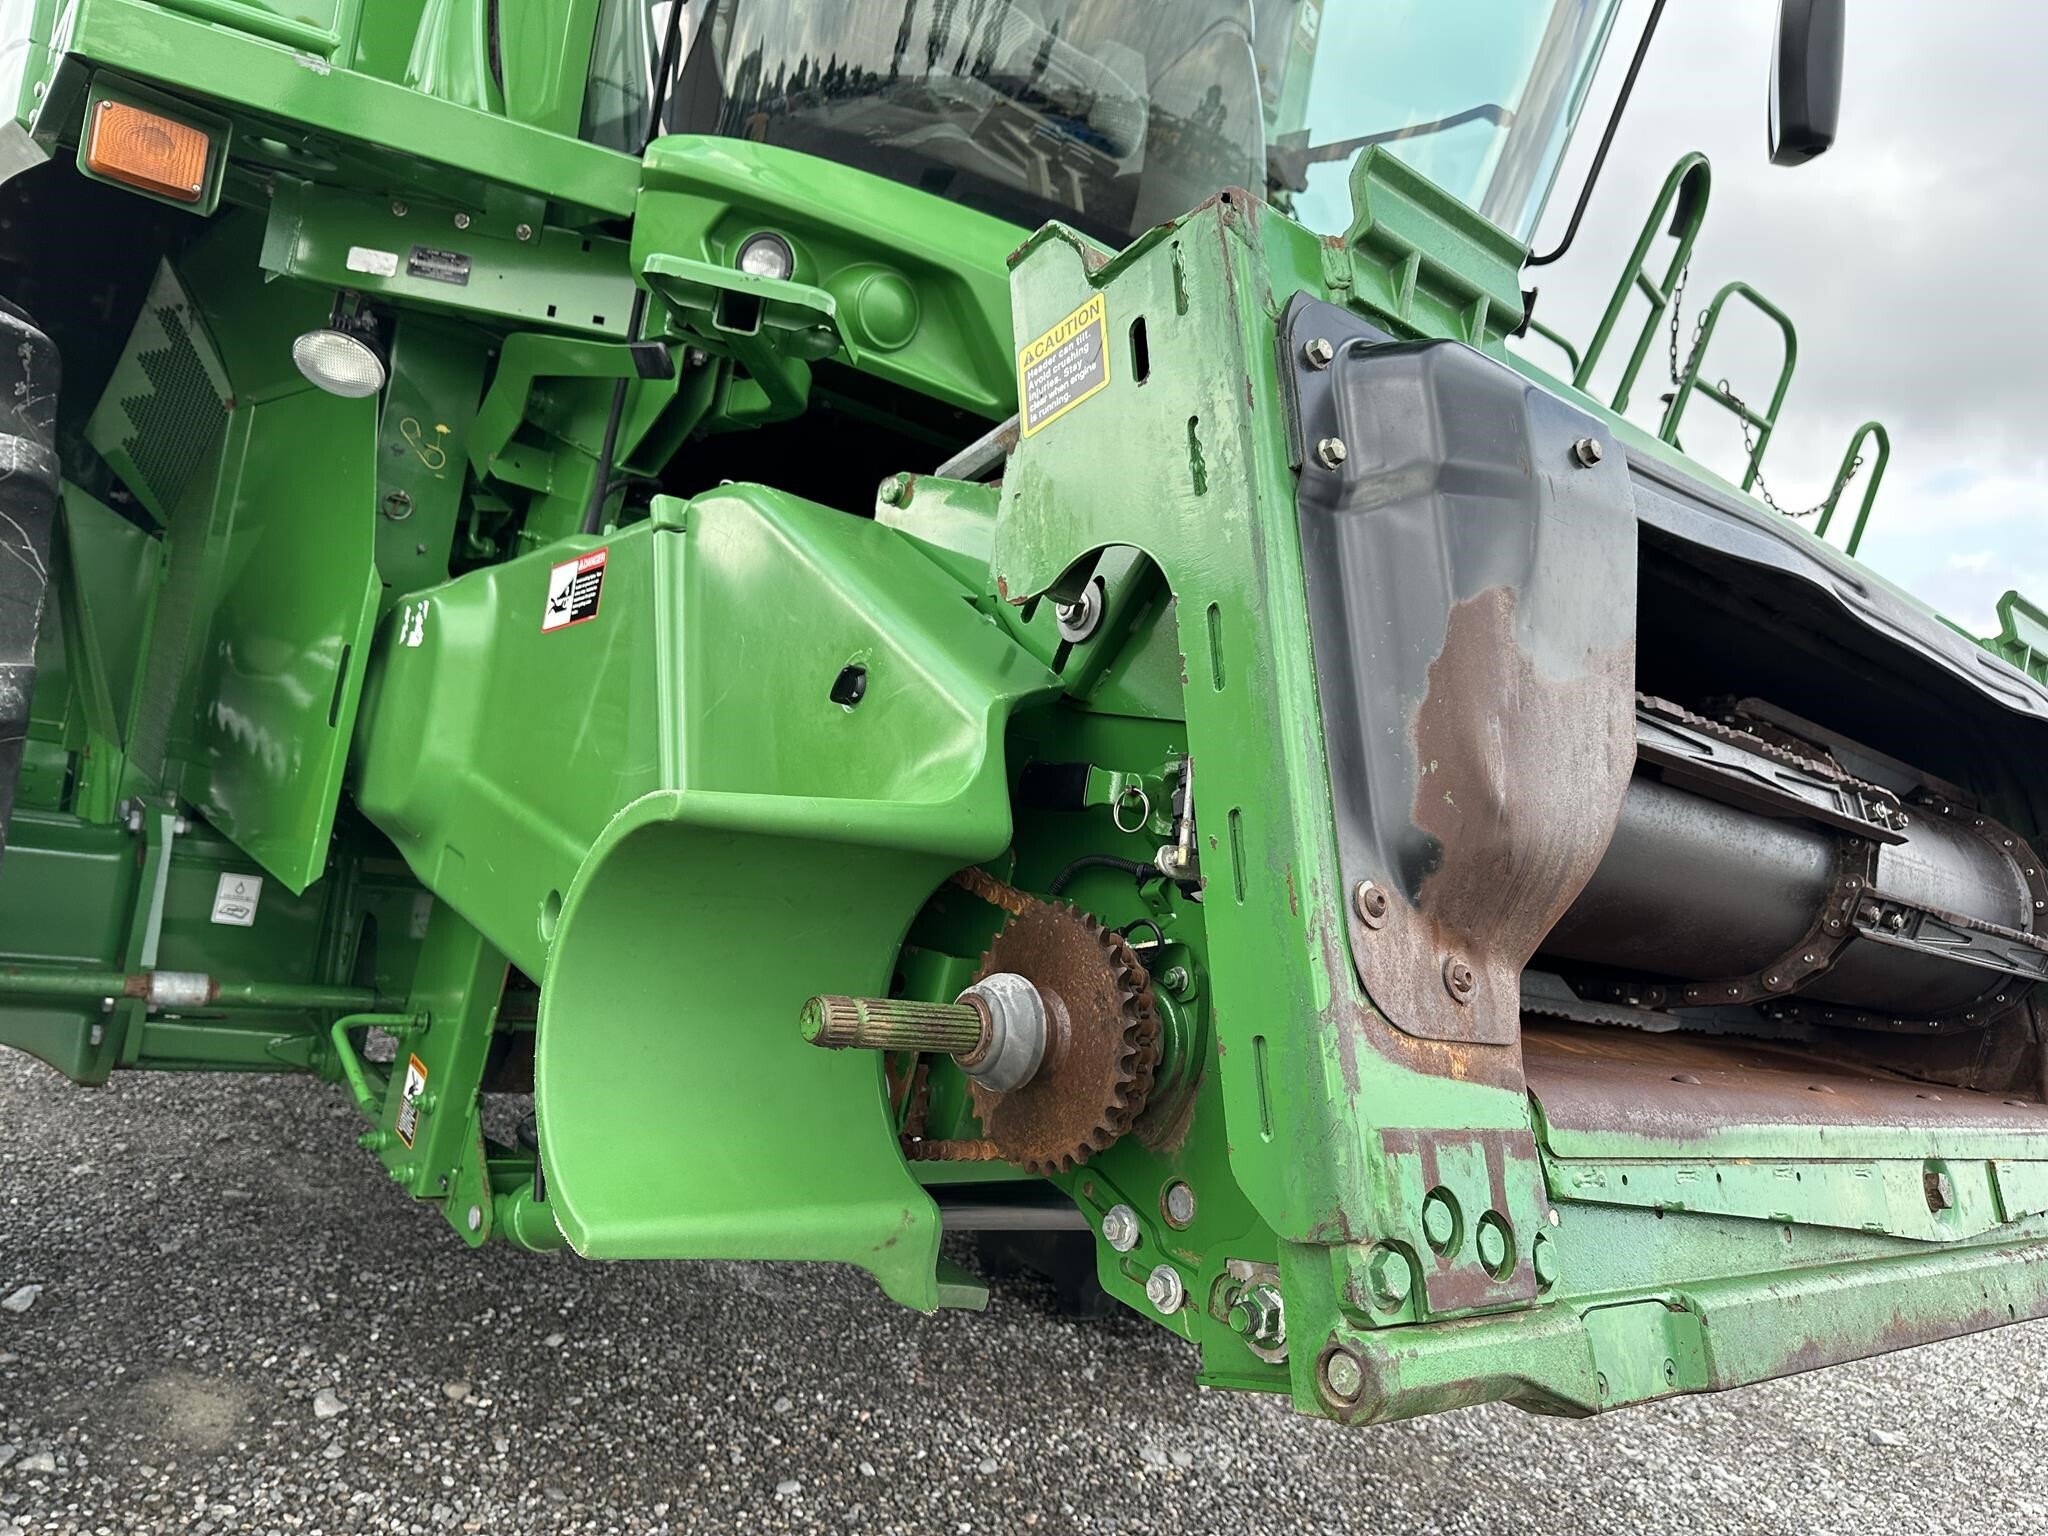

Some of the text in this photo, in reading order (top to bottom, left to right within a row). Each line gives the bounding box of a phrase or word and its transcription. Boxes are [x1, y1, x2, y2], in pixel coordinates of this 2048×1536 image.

[1035, 301, 1099, 357] CAUTION
[1028, 330, 1091, 380] Header can tilt.
[1028, 342, 1089, 391] Avoid crushing
[1028, 359, 1083, 402] injuries. Stay
[1029, 362, 1097, 412] clear when engine
[1030, 393, 1072, 423] is running.
[583, 552, 606, 568] DANGER
